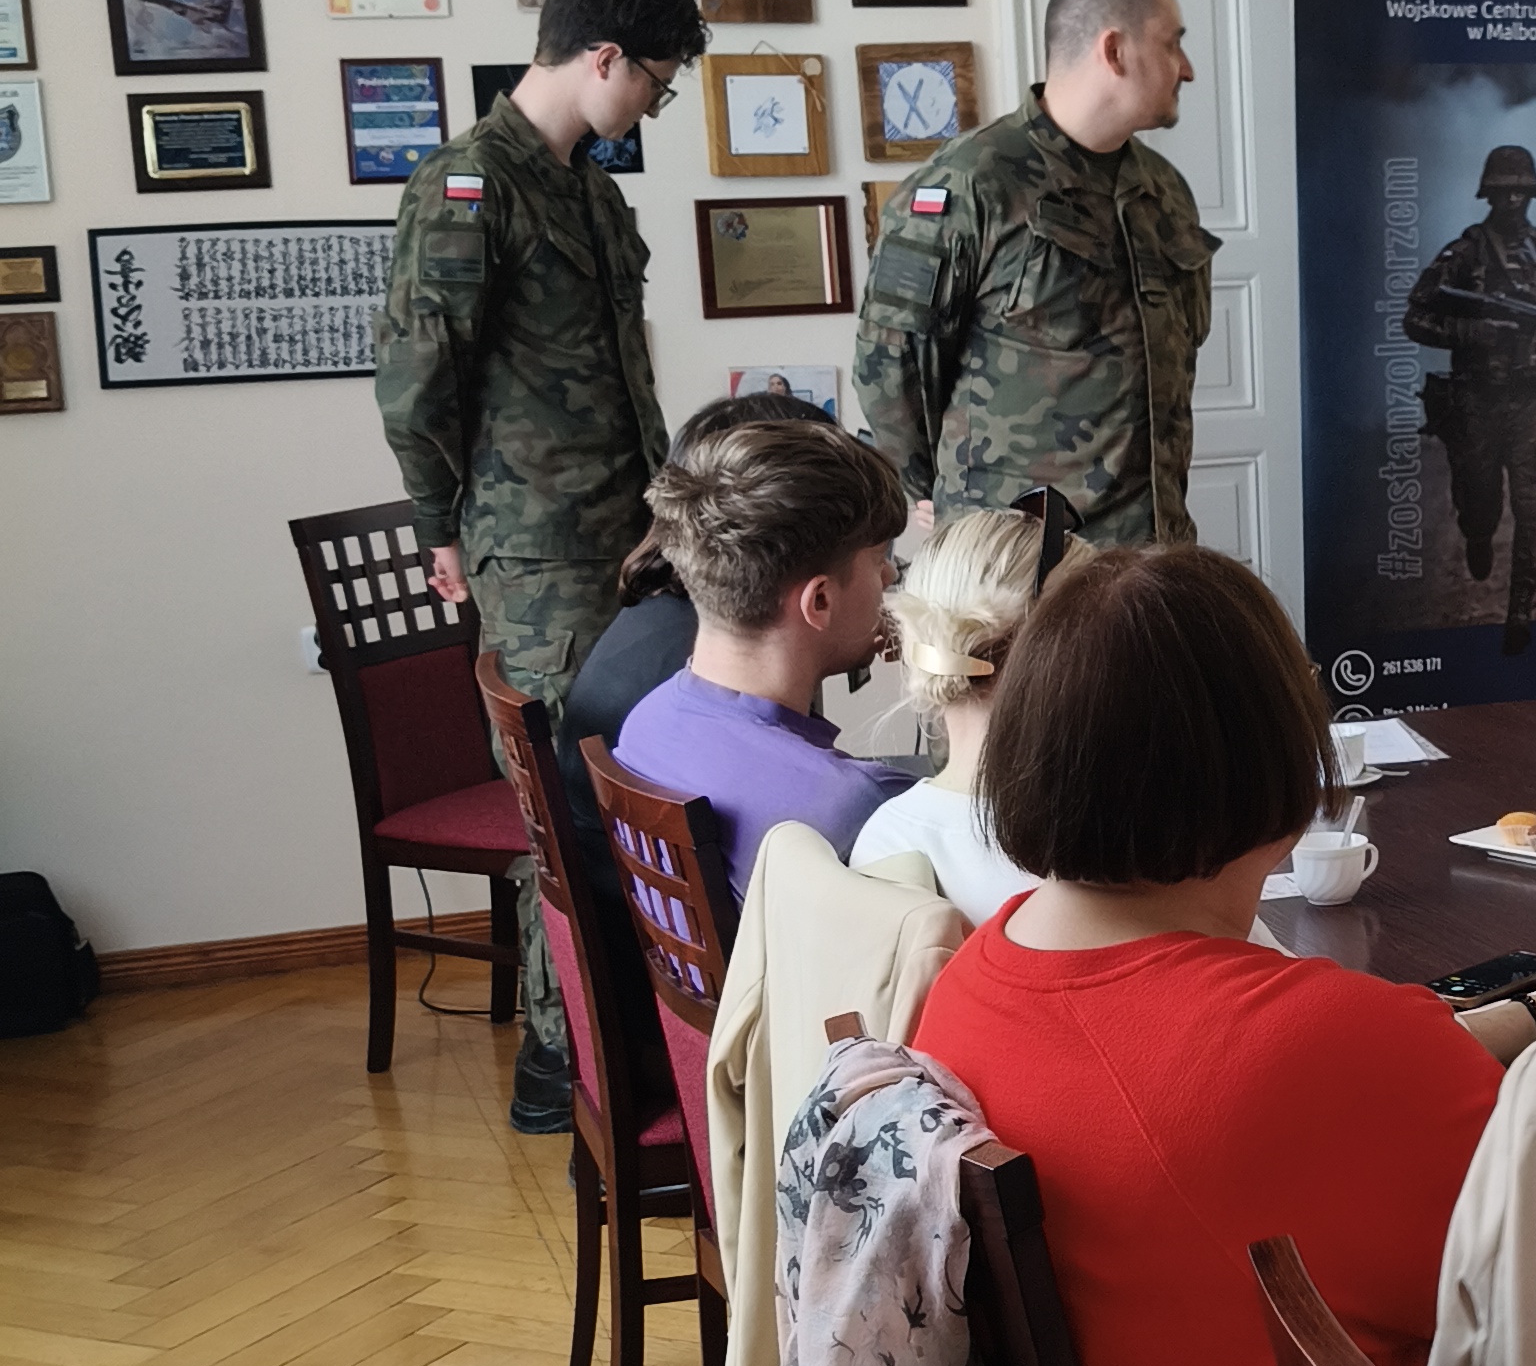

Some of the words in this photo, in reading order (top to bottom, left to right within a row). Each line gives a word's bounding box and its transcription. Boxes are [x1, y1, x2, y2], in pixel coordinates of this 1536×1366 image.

[1386, 0, 1478, 22] Wojskowe
[1467, 26, 1484, 40] w
[1375, 156, 1422, 581] #zostanzolnierzem
